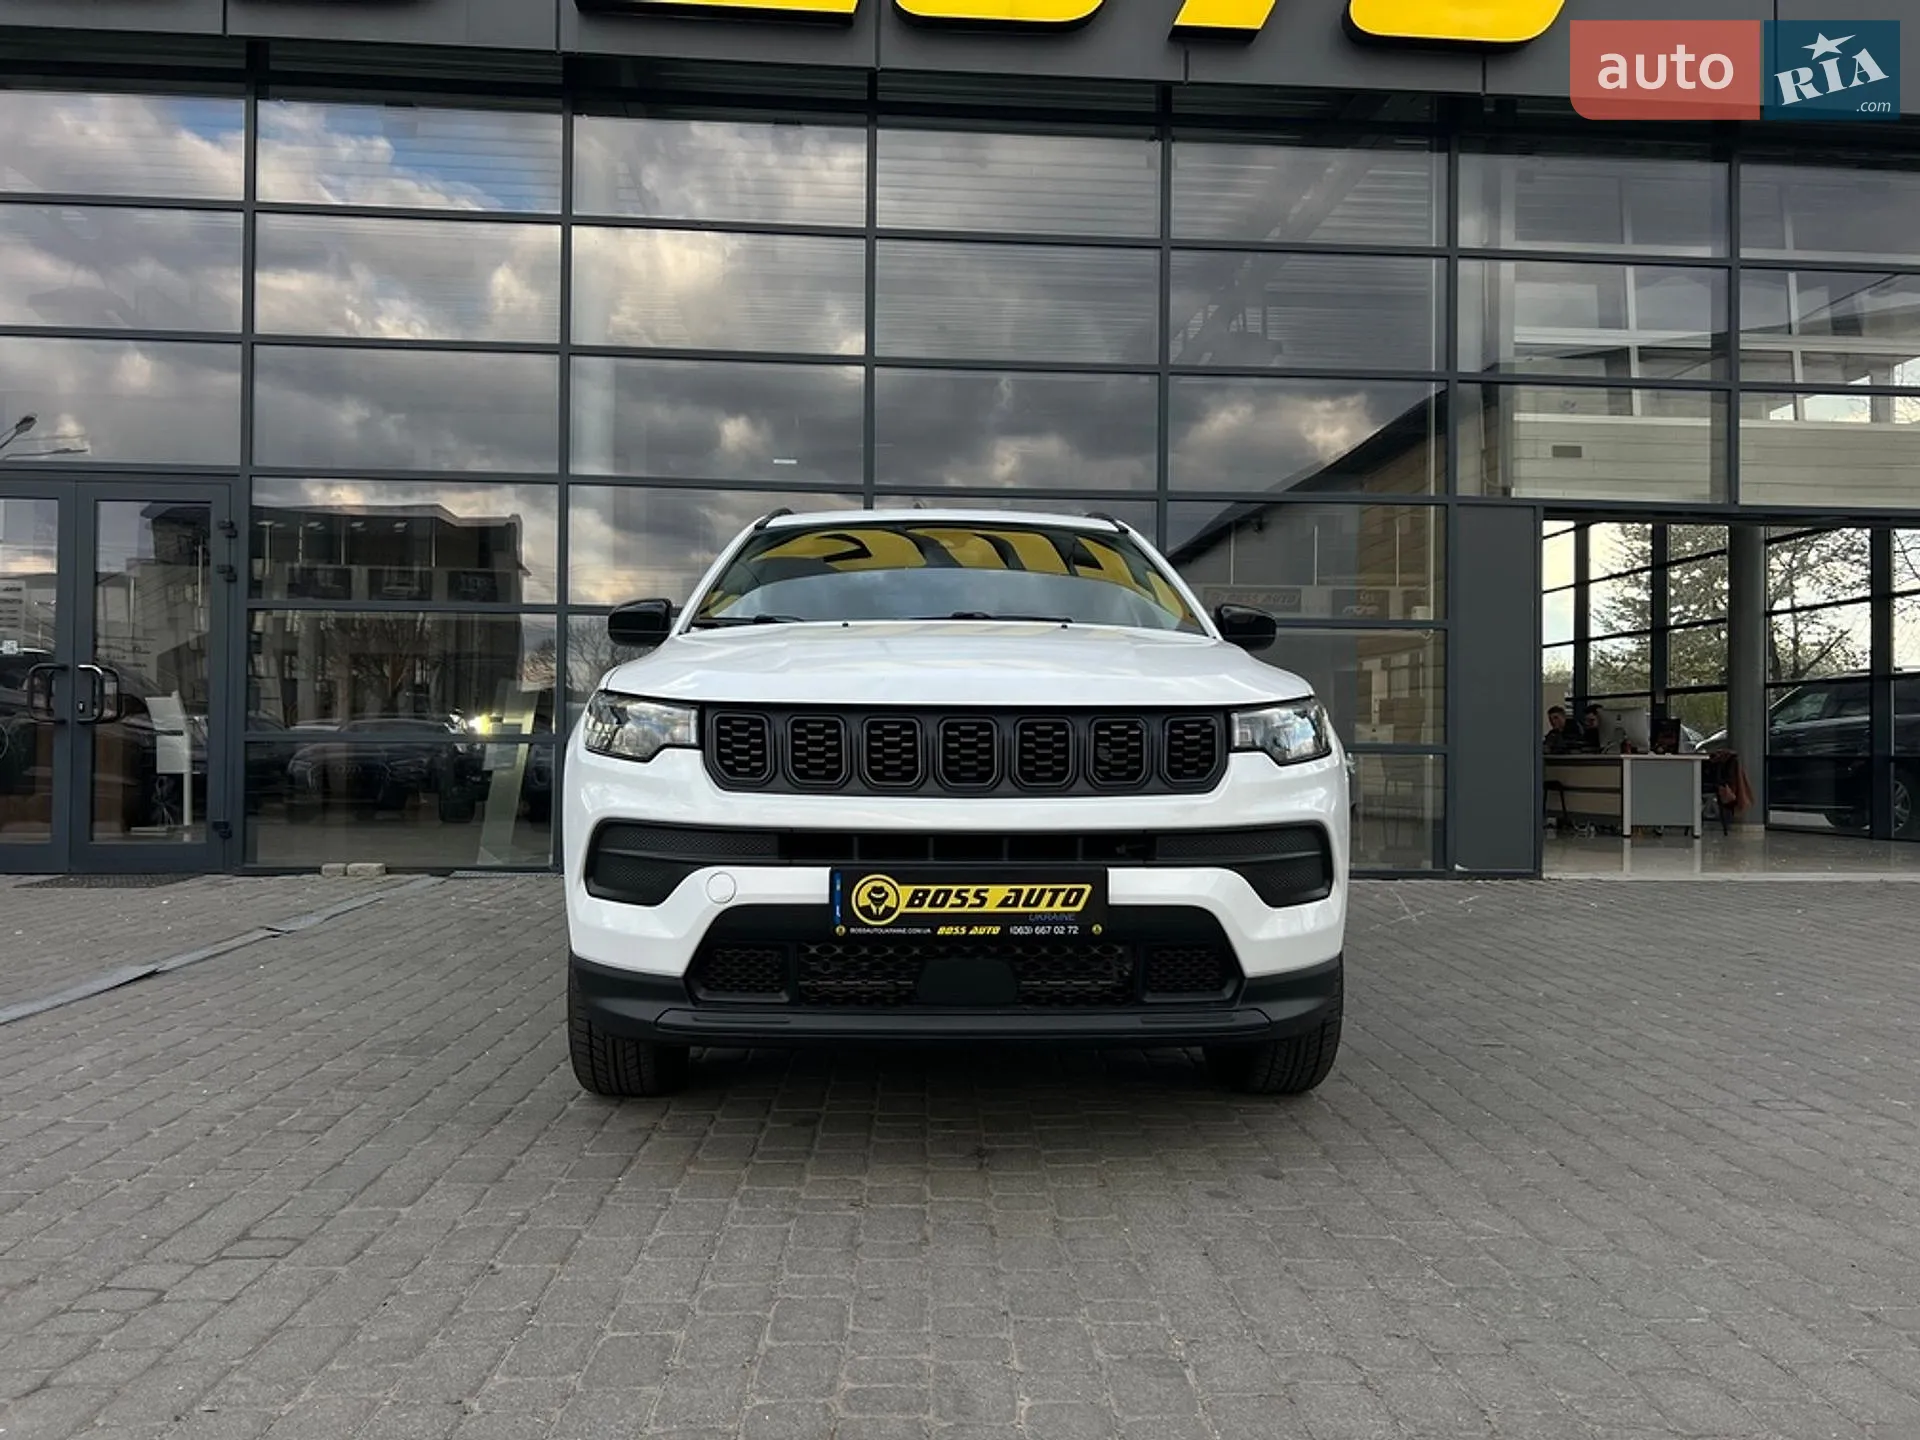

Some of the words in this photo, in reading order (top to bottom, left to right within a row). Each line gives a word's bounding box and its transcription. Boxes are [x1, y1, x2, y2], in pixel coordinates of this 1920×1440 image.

[905, 888, 989, 908] BOSS
[996, 888, 1086, 908] AUTO
[936, 926, 967, 935] BOSS
[969, 926, 1001, 935] AUTO
[1053, 926, 1066, 935] 02
[1067, 926, 1079, 935] 72
